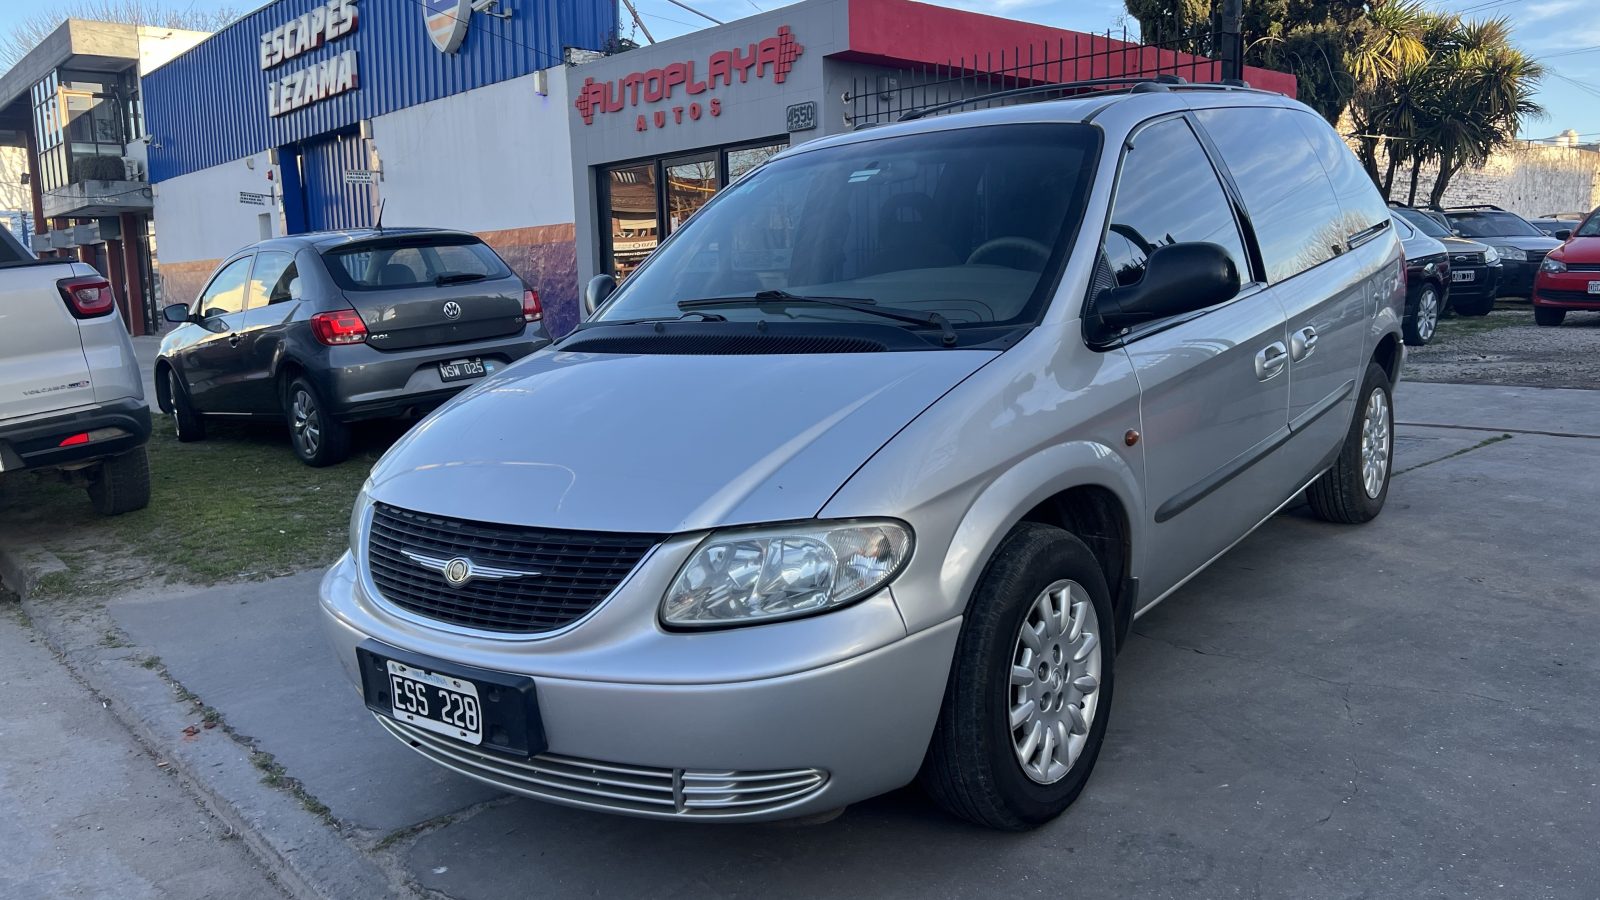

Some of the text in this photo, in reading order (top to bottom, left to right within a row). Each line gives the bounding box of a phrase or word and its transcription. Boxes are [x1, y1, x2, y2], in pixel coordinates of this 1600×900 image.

[261, 0, 358, 70] ESCAPES
[269, 50, 358, 117] LEZAMA
[587, 32, 788, 116] AUTOPLAYA
[636, 98, 721, 132] AUTOS
[788, 104, 813, 123] 4550
[440, 361, 484, 379] NSW 025
[392, 675, 428, 716] ESS
[438, 690, 477, 731] 228
